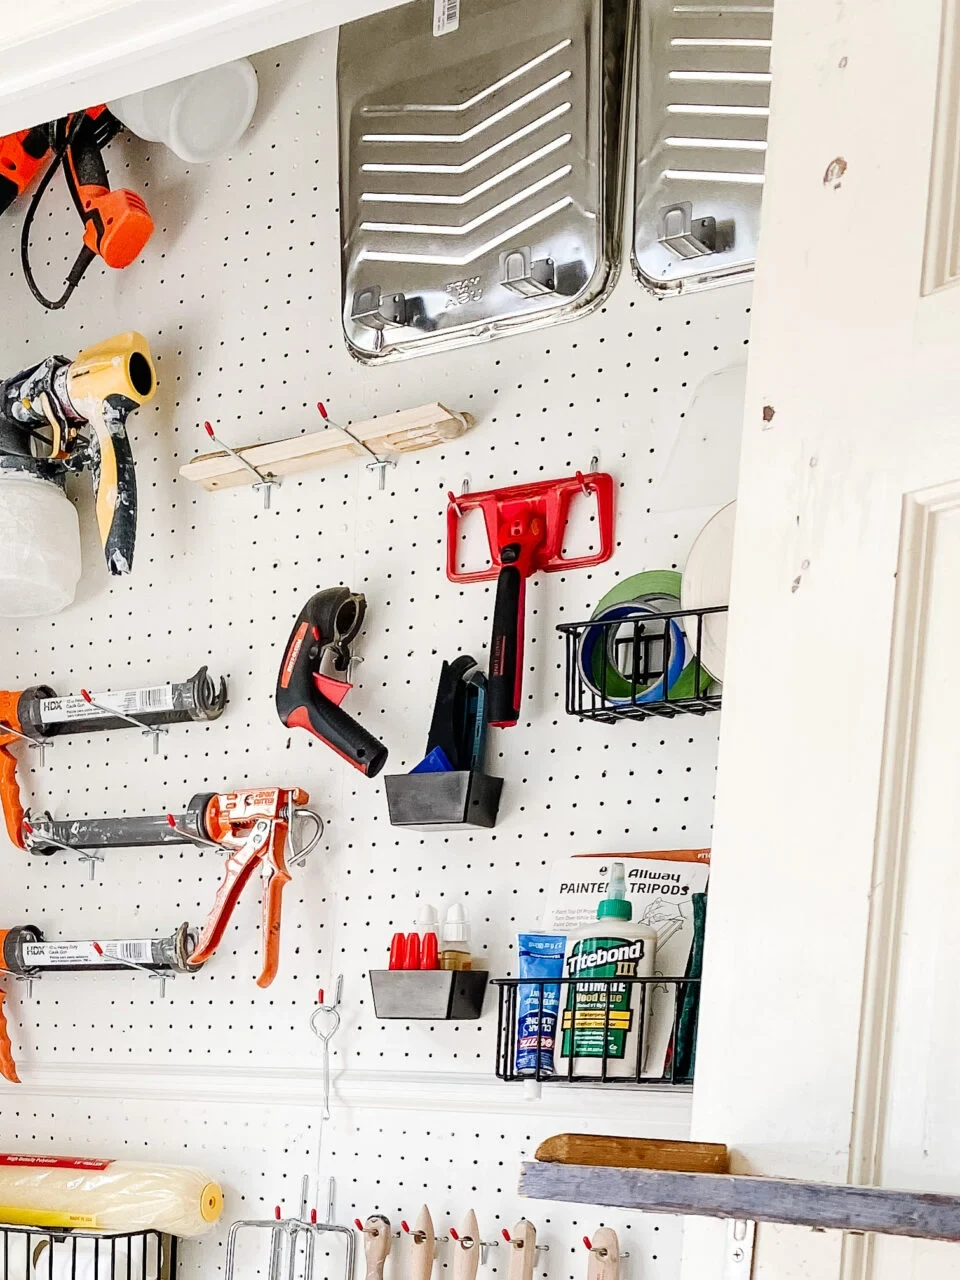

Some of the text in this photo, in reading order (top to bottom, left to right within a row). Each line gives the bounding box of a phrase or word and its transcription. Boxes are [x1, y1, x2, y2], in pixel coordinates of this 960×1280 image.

[43, 700, 63, 711] HDX
[628, 868, 681, 883] Allway
[559, 882, 690, 896] PAINTE TRIPODS
[26, 946, 45, 956] HDX
[568, 941, 642, 973] Titebond
[616, 961, 636, 976] III
